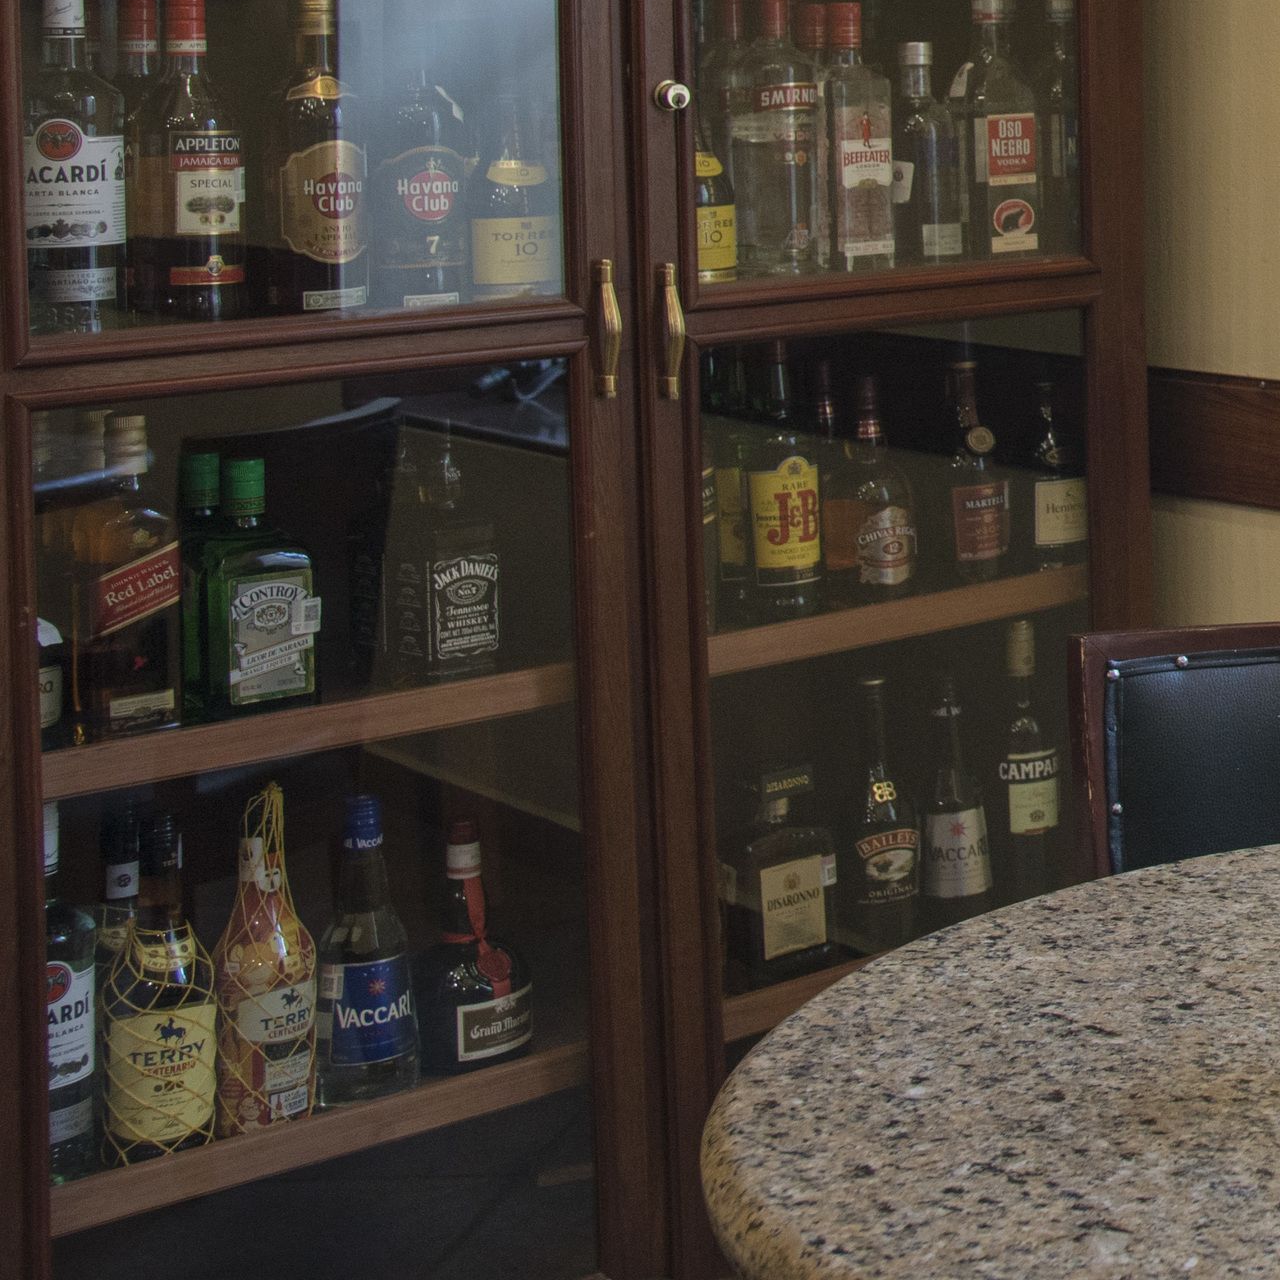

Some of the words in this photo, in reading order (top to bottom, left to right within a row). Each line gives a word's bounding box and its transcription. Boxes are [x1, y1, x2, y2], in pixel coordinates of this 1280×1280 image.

[998, 119, 1023, 138] OSO
[174, 137, 241, 152] APPLETON
[991, 137, 1031, 157] NEGRO
[179, 157, 222, 168] JAMAICA
[843, 150, 891, 167] BEEFEATER
[996, 157, 1028, 167] VODKA
[25, 158, 108, 185] ACARDÍ
[26, 189, 54, 198] ARTA
[58, 188, 100, 197] BLANCA
[189, 178, 233, 189] SPECIAL
[303, 177, 362, 196] Havana
[397, 177, 459, 196] Havana
[318, 195, 354, 212] Club
[411, 195, 449, 212] Club
[426, 235, 441, 255] 7
[704, 230, 723, 244] 10
[515, 241, 539, 257] 10
[857, 527, 894, 546] CHIVAS
[104, 583, 137, 607] Red
[136, 564, 177, 593] Label
[433, 564, 461, 590] JACK
[446, 603, 490, 617] Tennessee
[447, 615, 490, 629] WHISKEY
[860, 831, 919, 854] BAILEYS
[766, 886, 820, 913] DISARONNO
[260, 1006, 313, 1031] TERRY
[335, 989, 412, 1030] VACCARI
[469, 1020, 503, 1041] Grand
[128, 1038, 206, 1068] TERRY
